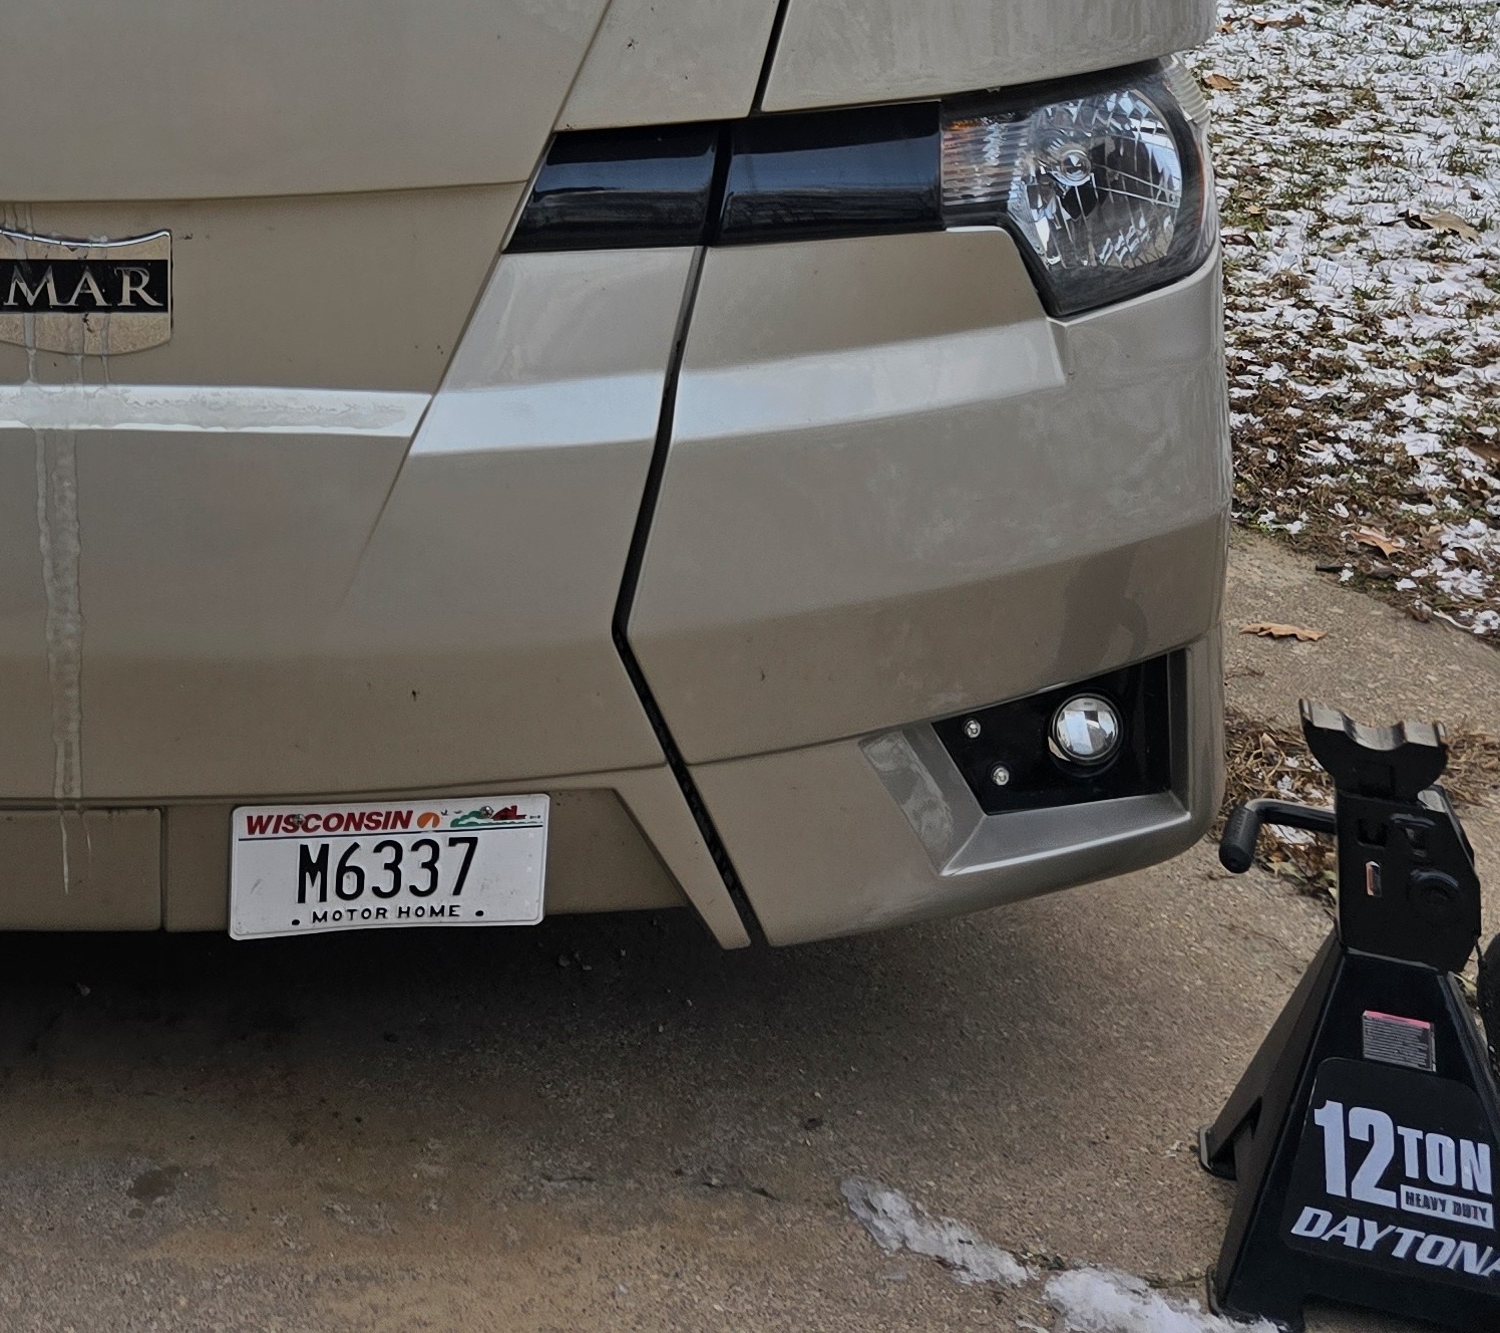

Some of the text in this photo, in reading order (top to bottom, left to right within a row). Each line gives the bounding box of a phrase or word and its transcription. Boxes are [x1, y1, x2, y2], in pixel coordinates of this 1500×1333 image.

[246, 810, 414, 835] WISCONSIN
[297, 836, 479, 904] M6337
[312, 904, 461, 923] MOTOR HOME
[1313, 1099, 1493, 1209] 12 TON
[1405, 1190, 1488, 1222] HEAVY DUTY
